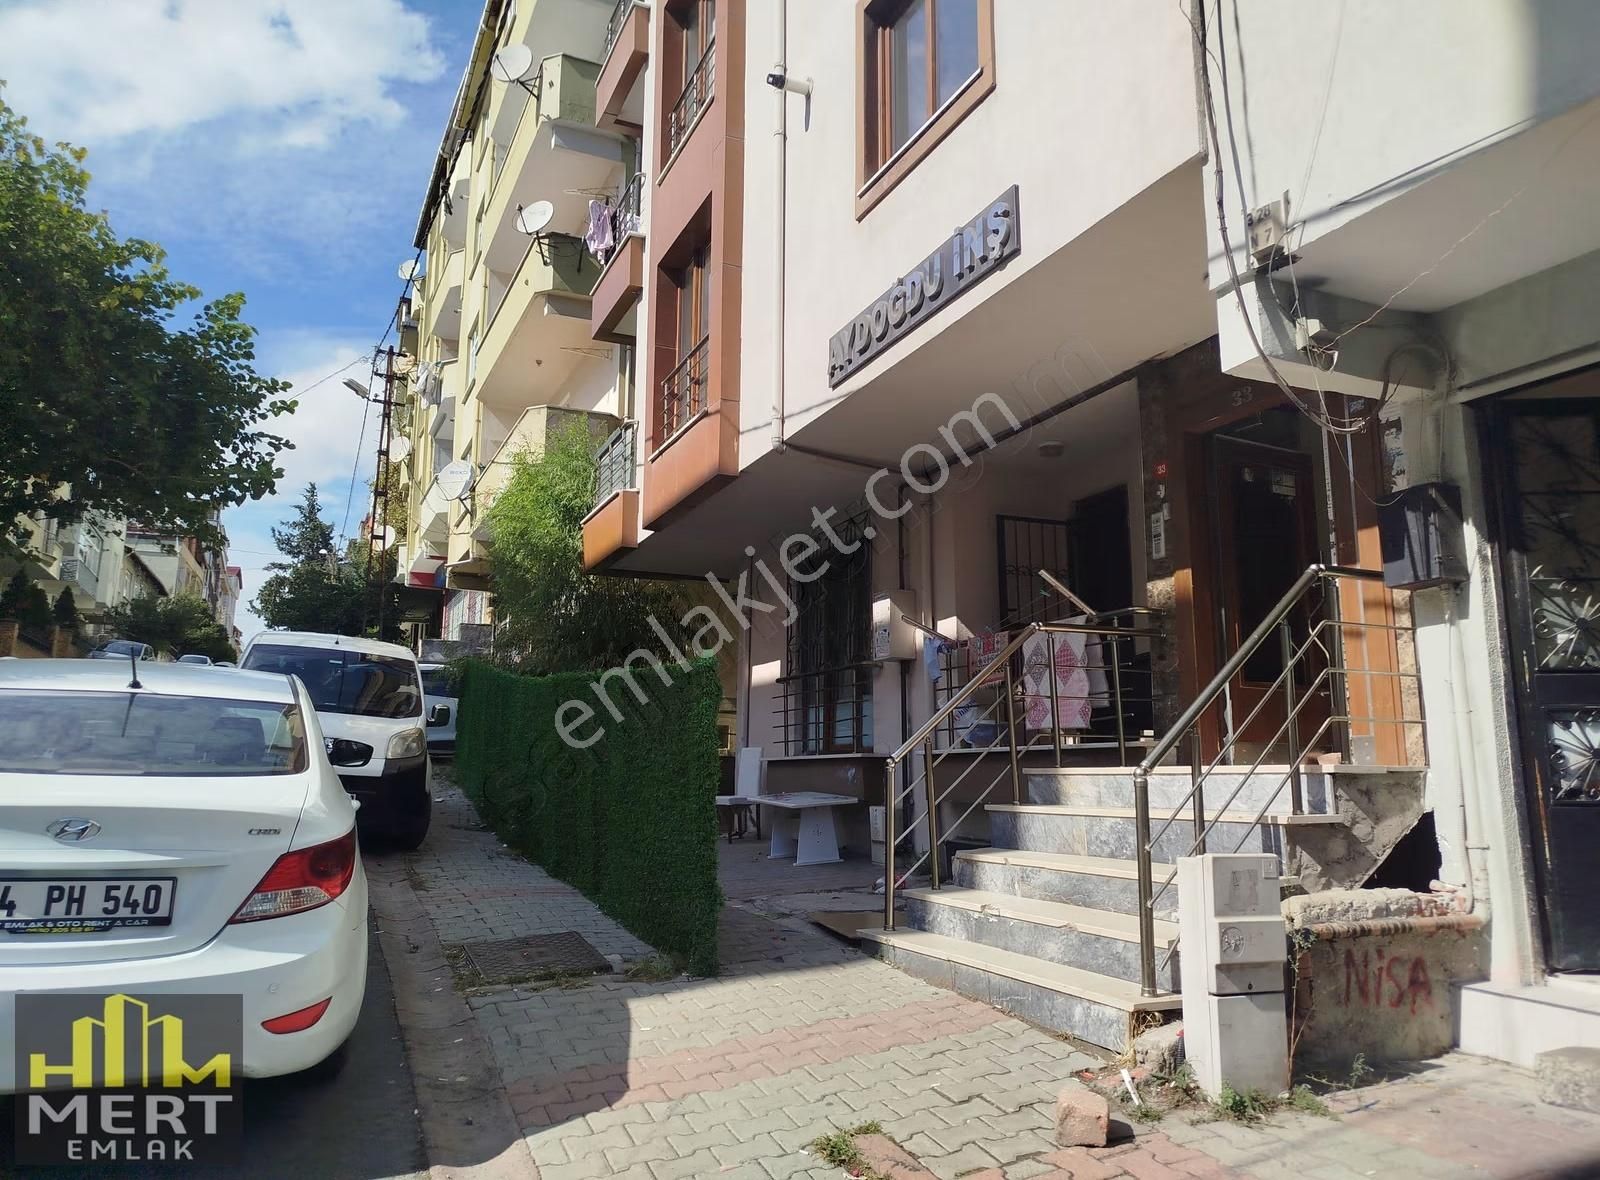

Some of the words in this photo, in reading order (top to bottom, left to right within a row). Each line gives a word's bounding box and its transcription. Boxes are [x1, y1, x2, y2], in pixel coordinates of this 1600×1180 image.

[828, 251, 945, 378] AYDOĞDU
[1232, 385, 1253, 407] 33
[44, 885, 86, 916] PH
[102, 884, 162, 915] 540
